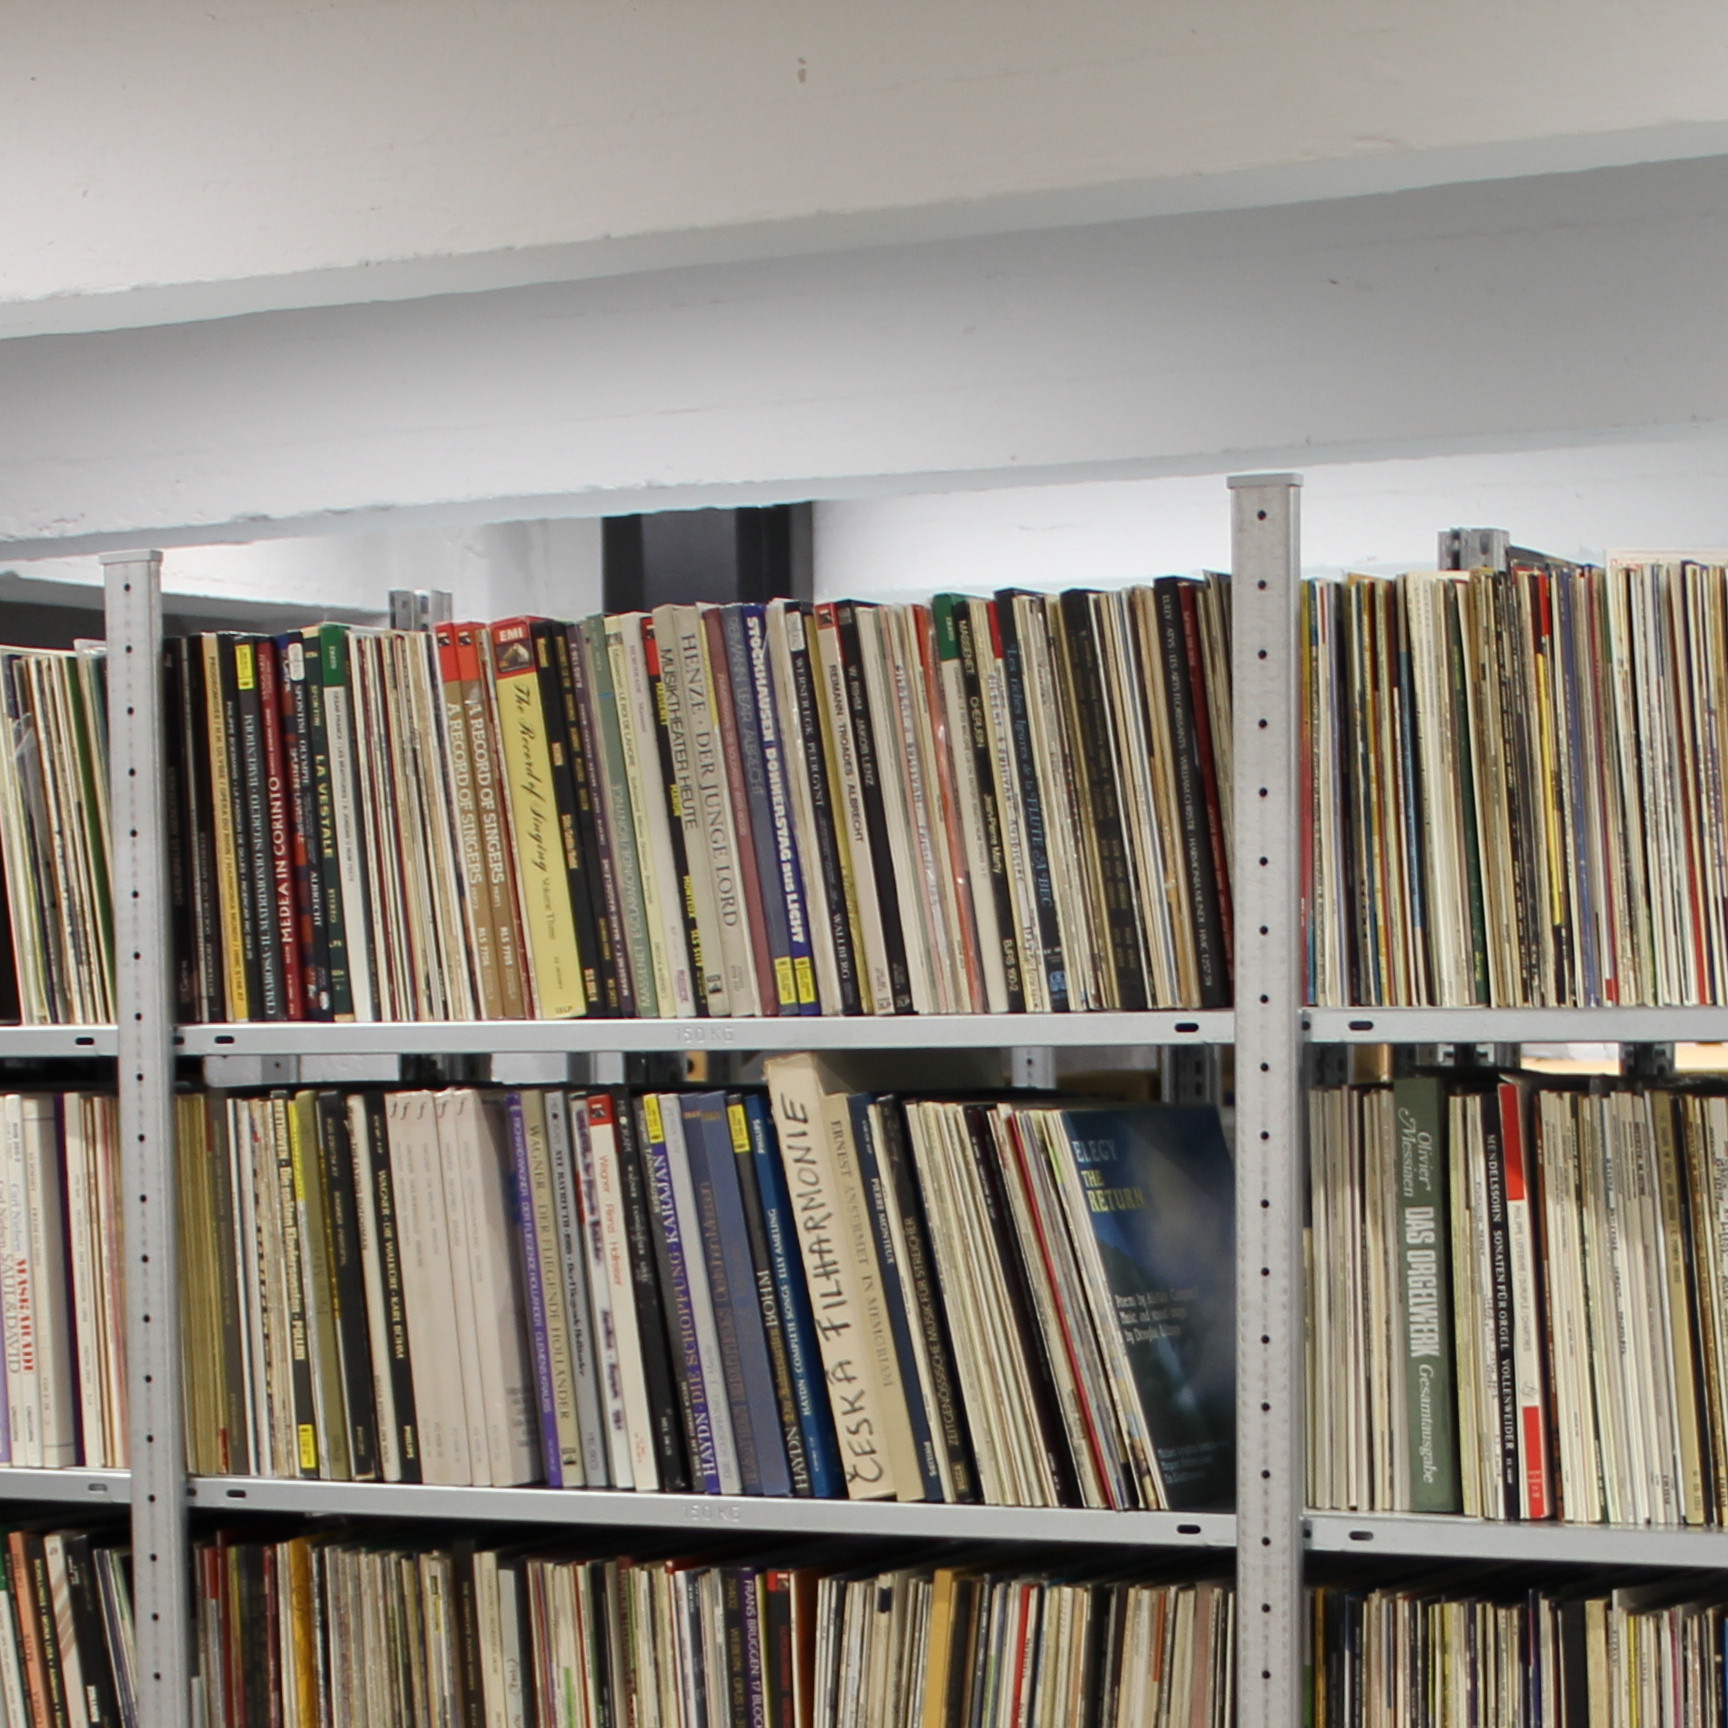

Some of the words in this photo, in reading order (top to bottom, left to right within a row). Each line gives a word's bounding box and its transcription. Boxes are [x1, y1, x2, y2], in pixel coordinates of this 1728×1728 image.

[499, 629, 524, 642] EMI
[682, 634, 710, 715] HENZE
[747, 616, 776, 741] STOCKHAUSEN
[796, 658, 812, 708] WERNER
[828, 665, 845, 716] REIMANN
[849, 681, 864, 710] RIHM
[446, 702, 461, 714] A
[467, 704, 481, 714] A
[802, 710, 815, 734] EGK
[448, 718, 470, 784] RECORD
[469, 719, 491, 784] RECORD
[661, 649, 691, 771] MUSIKTHEATER
[677, 776, 698, 829] HEUTE
[695, 731, 718, 774] DER
[806, 742, 820, 769] PEER
[836, 722, 854, 776] TROADES
[855, 717, 870, 755] JAKOB
[314, 755, 327, 772] LA
[861, 758, 875, 785] LENZ
[457, 788, 473, 809] OF
[478, 789, 494, 809] OF
[765, 748, 793, 860] DONNERSTAG
[810, 774, 824, 806] GYNT
[845, 784, 864, 841] ALBRECHT
[267, 777, 286, 856] CORINTO
[316, 778, 334, 858] VESTALE
[703, 784, 730, 860] JUNGE
[274, 860, 288, 879] IN
[460, 814, 482, 883] SINGERS
[482, 814, 504, 883] SINGERS
[715, 870, 740, 927] LORD
[780, 863, 797, 892] aus
[275, 883, 293, 942] MEDEA
[785, 895, 804, 943] LICHT
[831, 914, 851, 978] WALLBERG
[831, 1120, 854, 1177] ERNEST
[1400, 1108, 1417, 1197] Messiaen
[1417, 1131, 1432, 1191] Olivier
[870, 1178, 885, 1209] PIERRE
[1487, 1135, 1501, 1222] MENDELSSOHN
[768, 1209, 784, 1253] AMELING
[844, 1186, 871, 1265] ANSERMET
[876, 1213, 895, 1264] MONTEUX
[1404, 1206, 1435, 1244] DAS
[776, 1256, 788, 1277] ELLY
[1493, 1230, 1505, 1282] SONATEN
[781, 1285, 795, 1319] SONGS
[861, 1276, 876, 1293] IN
[1406, 1250, 1440, 1358] ORGELWERK
[15, 1258, 34, 1374] MASKARADE
[865, 1297, 893, 1386] MEMORIAM
[1497, 1311, 1509, 1351] ORGEL
[787, 1322, 803, 1372] COMPLETE
[796, 1379, 811, 1415] HAYDN
[1500, 1359, 1514, 1450] VOLLENWEIDER
[1417, 1364, 1436, 1484] Gesamtausgabe
